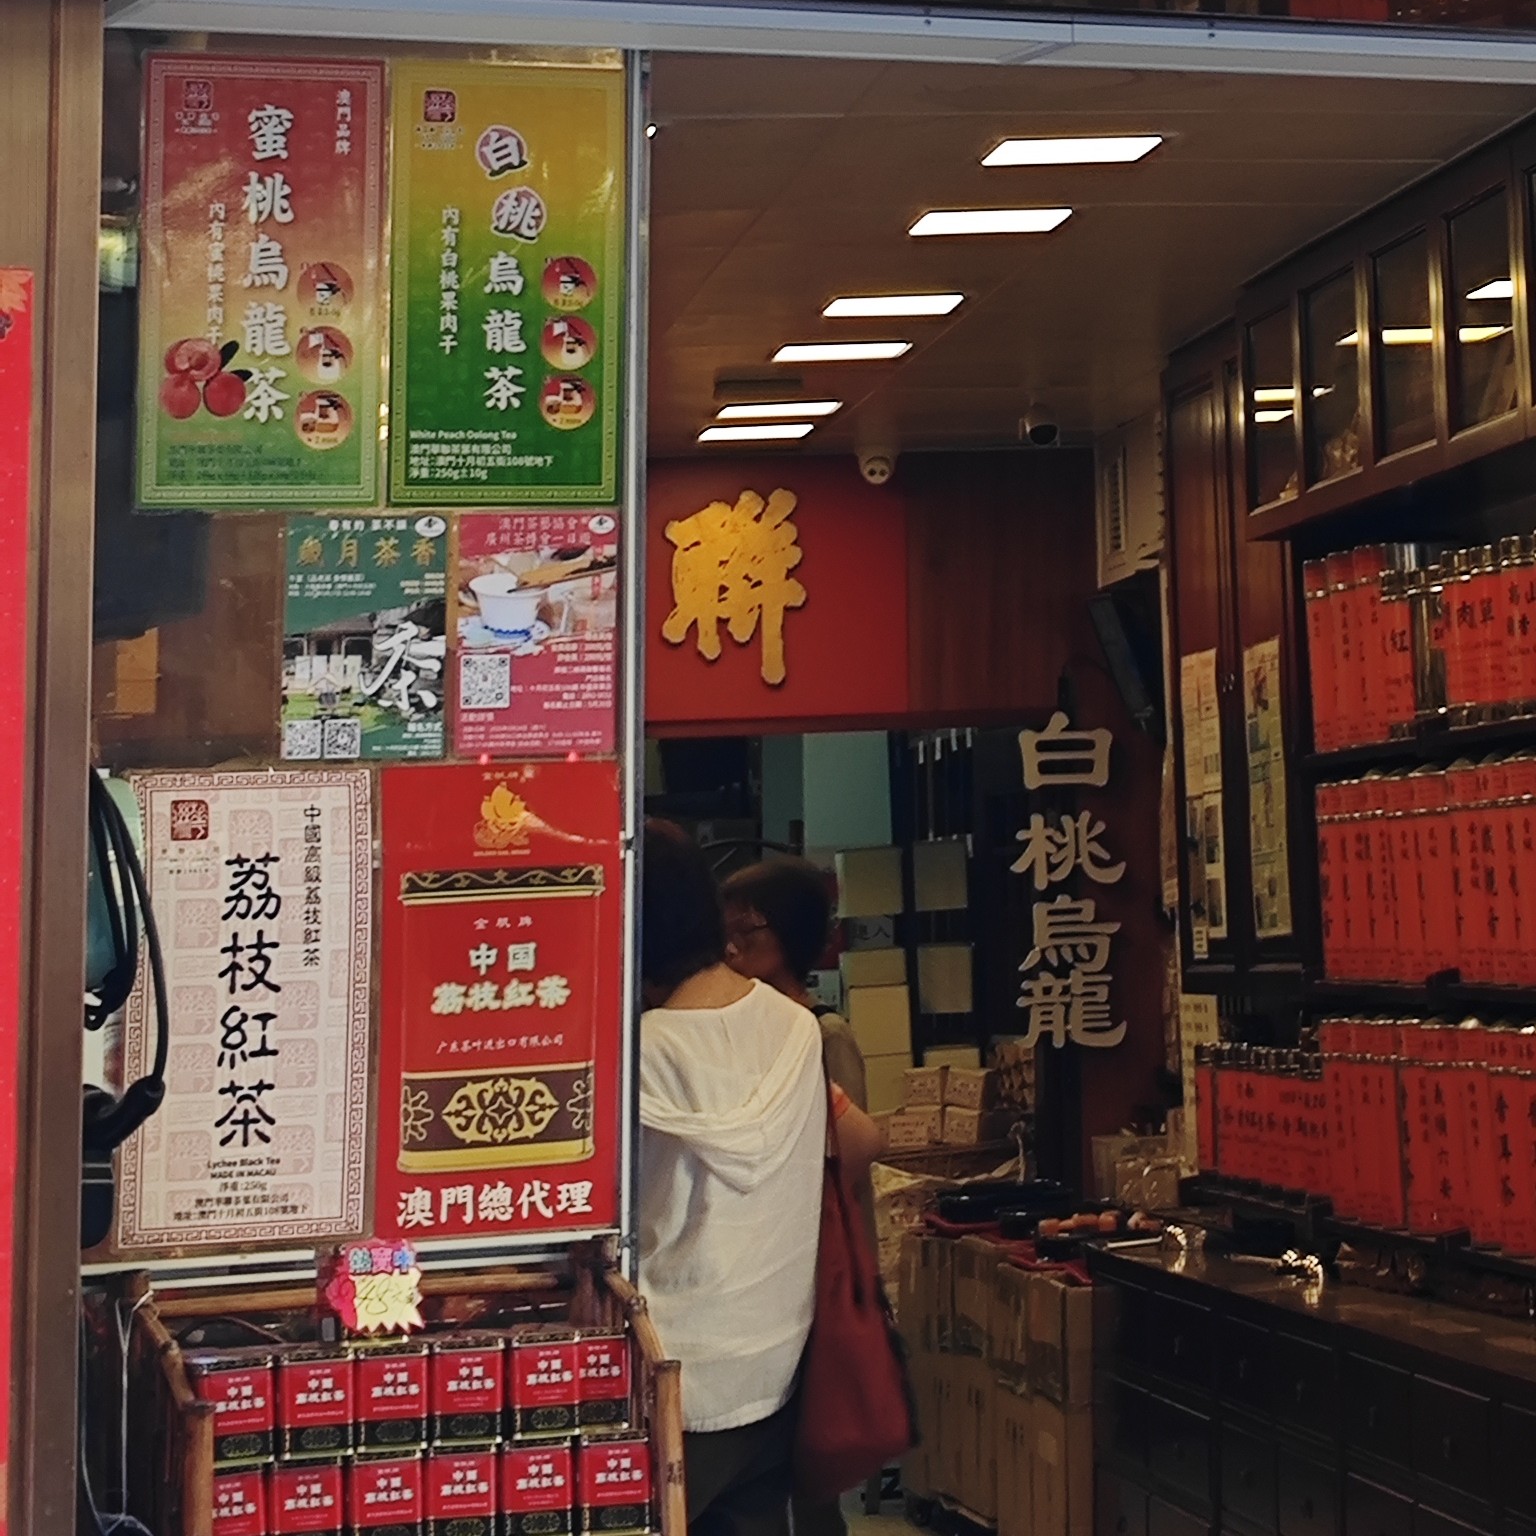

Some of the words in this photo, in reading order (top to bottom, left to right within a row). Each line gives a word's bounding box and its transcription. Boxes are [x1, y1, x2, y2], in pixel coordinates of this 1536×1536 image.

[335, 88, 352, 156] 澳門品牌
[241, 103, 295, 425] 蜜桃烏龍茶
[481, 128, 542, 412] 白桃烏龍茶
[1010, 710, 1127, 1049] 白桃烏龍
[469, 942, 537, 976] 中国
[214, 851, 283, 1148] 荔枝紅茶
[210, 1170, 233, 1179] MADE
[247, 1169, 276, 1178] MACAU
[240, 1158, 263, 1167] Black
[266, 1157, 280, 1166] Tea
[396, 1180, 593, 1229] 澳門總代理
